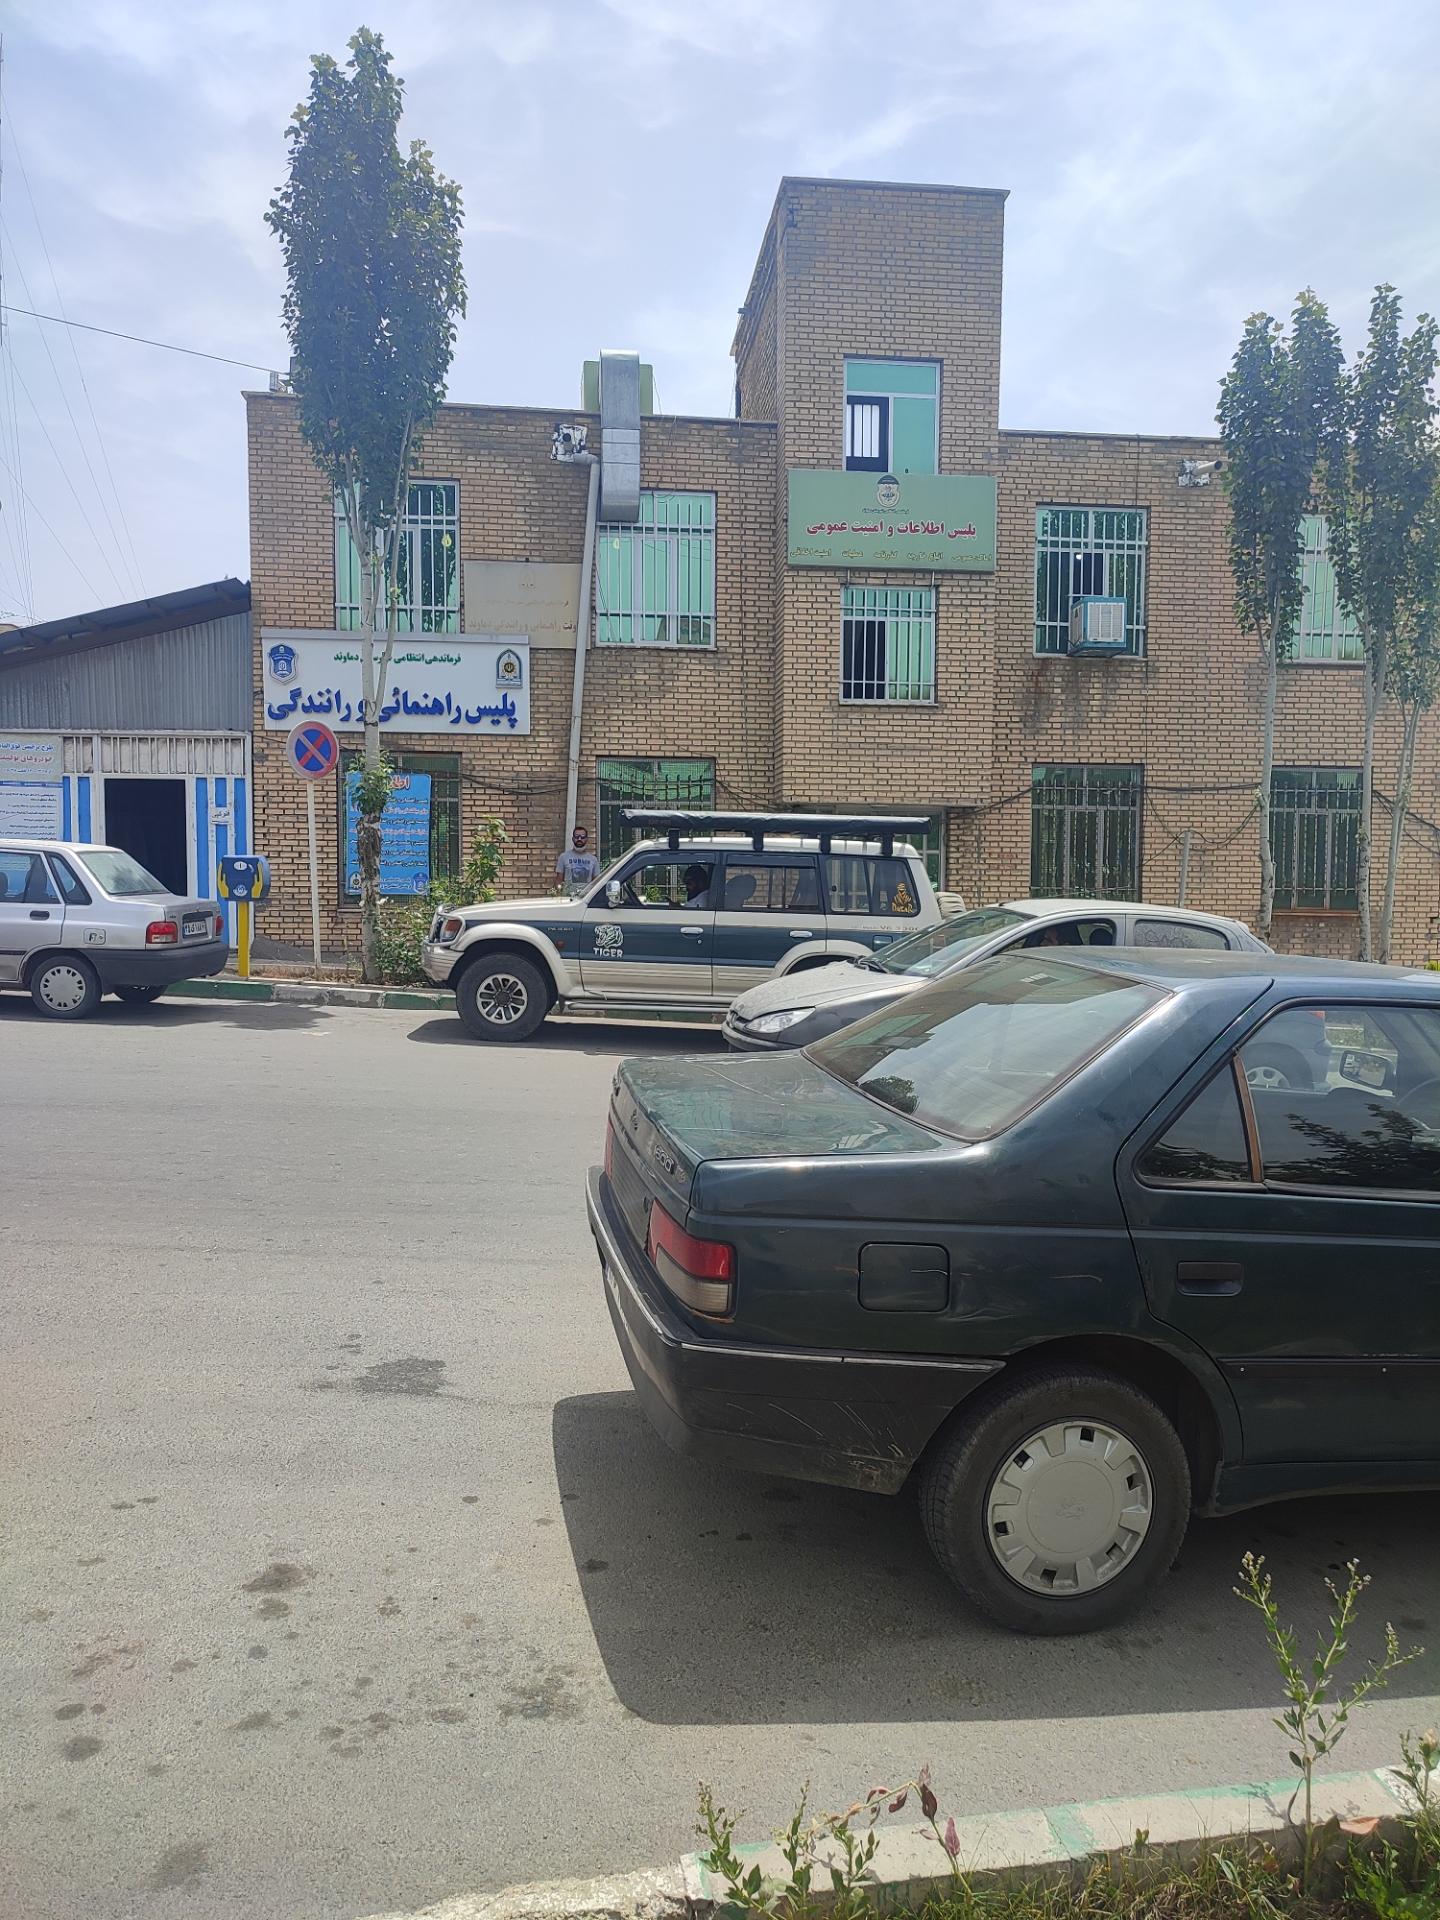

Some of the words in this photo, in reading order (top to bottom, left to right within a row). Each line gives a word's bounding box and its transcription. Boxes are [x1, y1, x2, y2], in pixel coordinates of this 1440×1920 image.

[806, 521, 848, 536] عمومی
[851, 519, 884, 536] امنیت
[886, 526, 894, 537] و
[896, 520, 945, 535] اطلاعات
[947, 523, 977, 540] پلیس
[333, 651, 360, 664] دماوند
[393, 652, 425, 664] انتظامی
[425, 653, 462, 665] فرماندهی
[267, 687, 352, 721] رانندگی
[465, 692, 519, 729] پلیس
[593, 947, 624, 958] TIGER
